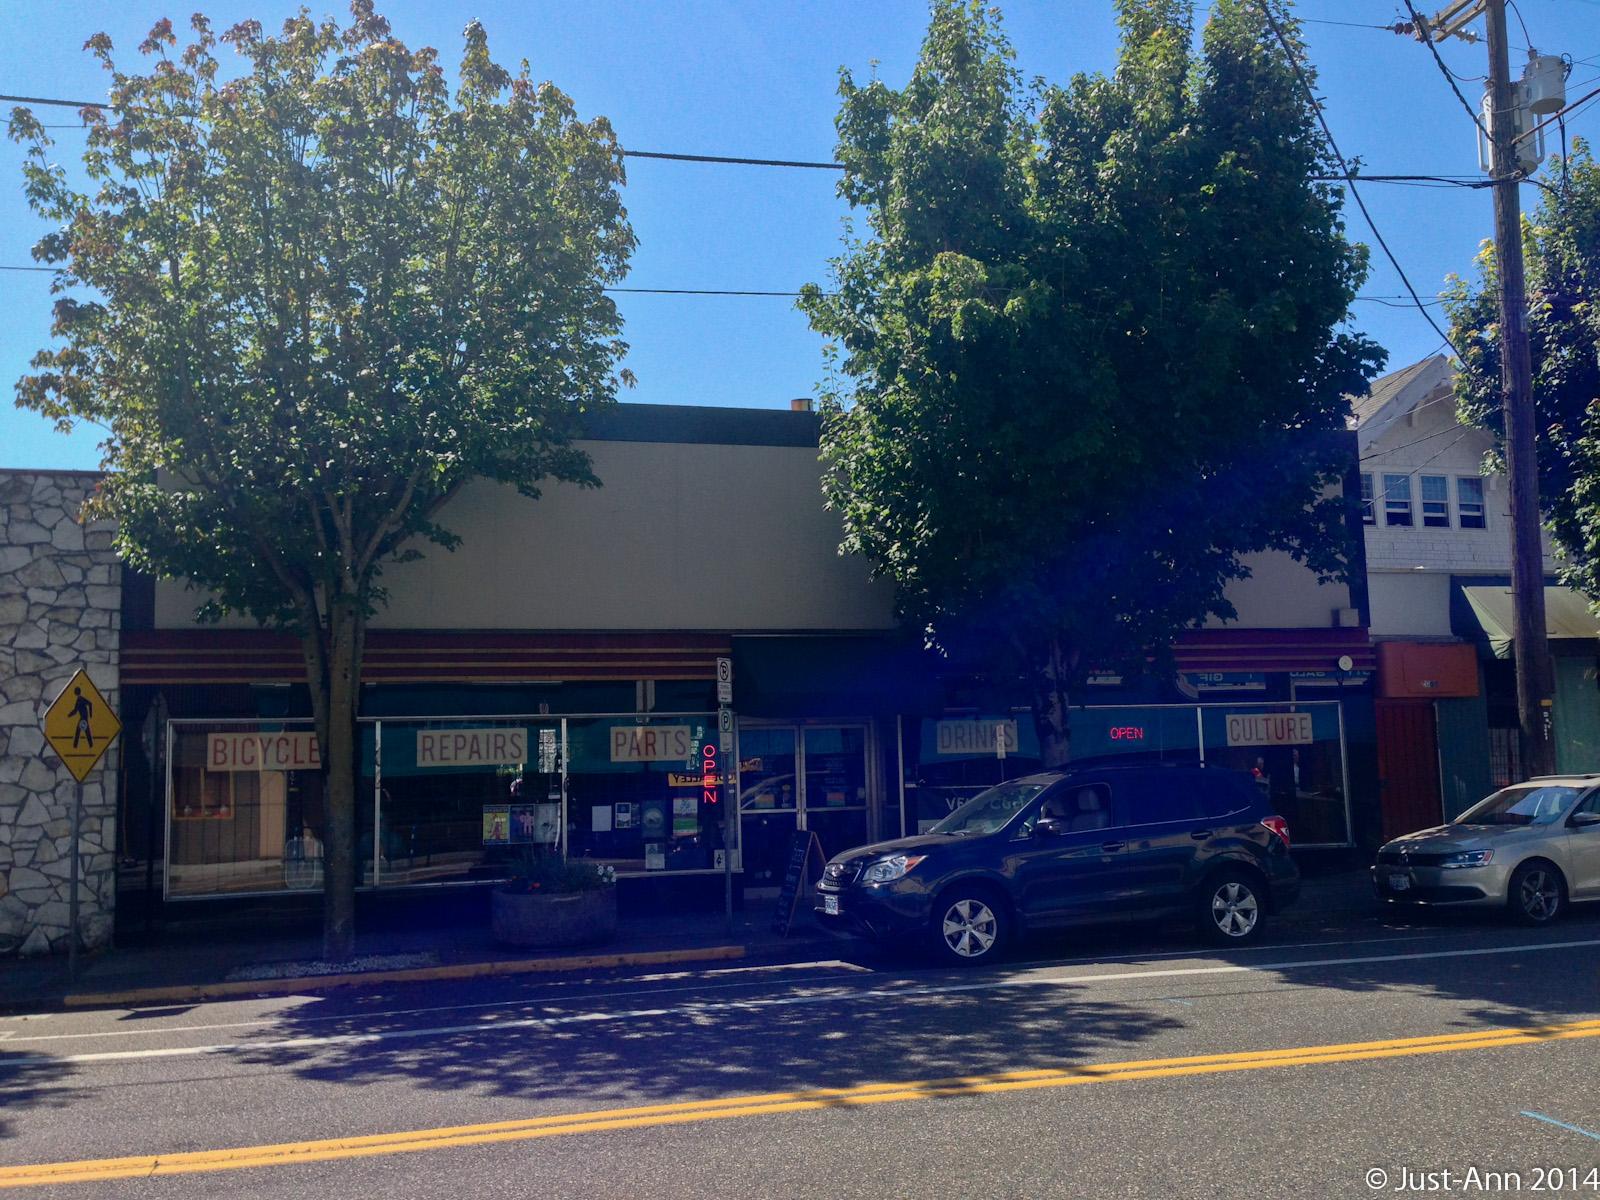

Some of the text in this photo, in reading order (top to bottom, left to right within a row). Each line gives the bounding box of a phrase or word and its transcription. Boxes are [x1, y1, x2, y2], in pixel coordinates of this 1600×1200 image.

[615, 729, 687, 758] PARTS
[1109, 726, 1144, 740] OPEN
[1230, 716, 1309, 744] CULTURE
[212, 735, 321, 766] BICYCLE
[421, 731, 523, 761] REPAIRS
[703, 745, 717, 804] OPEN
